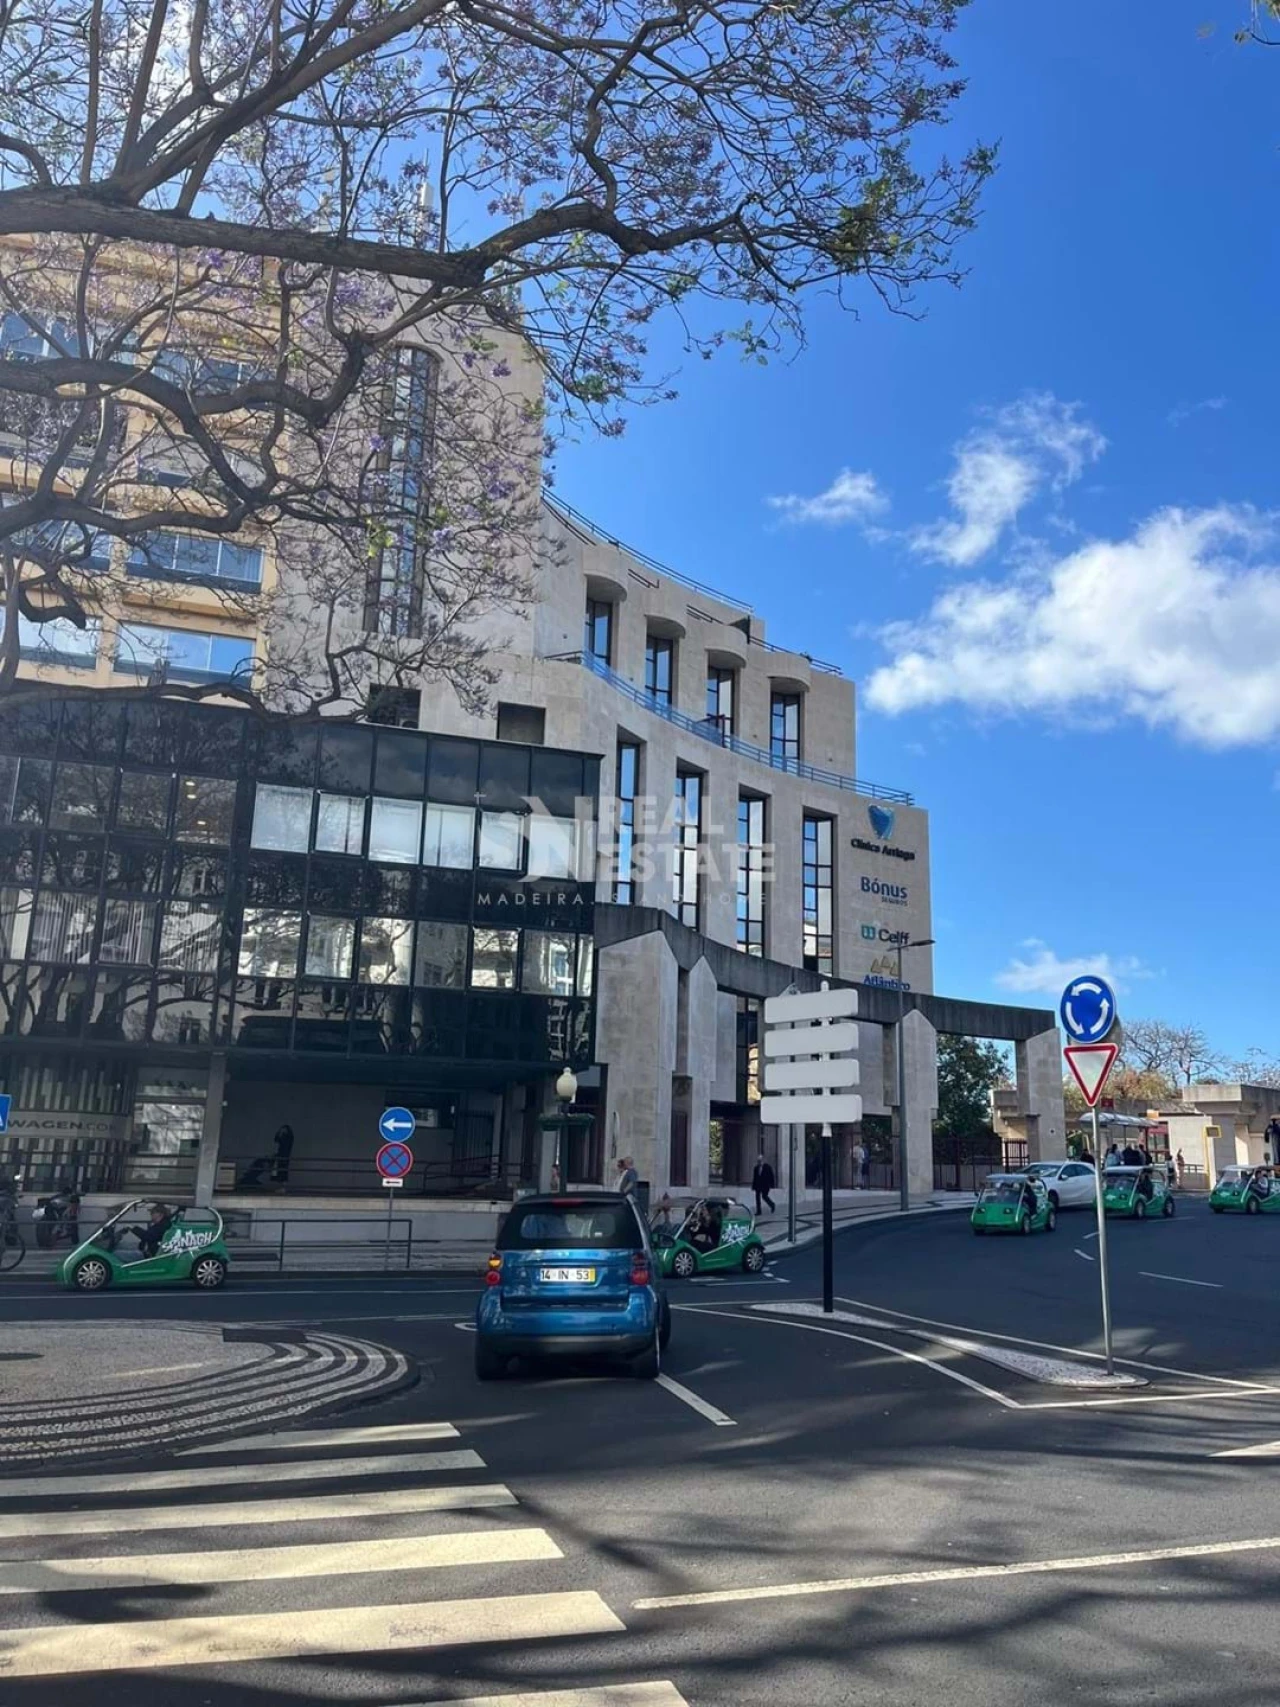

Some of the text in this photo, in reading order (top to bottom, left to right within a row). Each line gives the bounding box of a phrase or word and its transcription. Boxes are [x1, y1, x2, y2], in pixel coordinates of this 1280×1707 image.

[861, 876, 907, 899] Bónus
[558, 1270, 569, 1280] IN
[576, 1270, 589, 1280] 53
